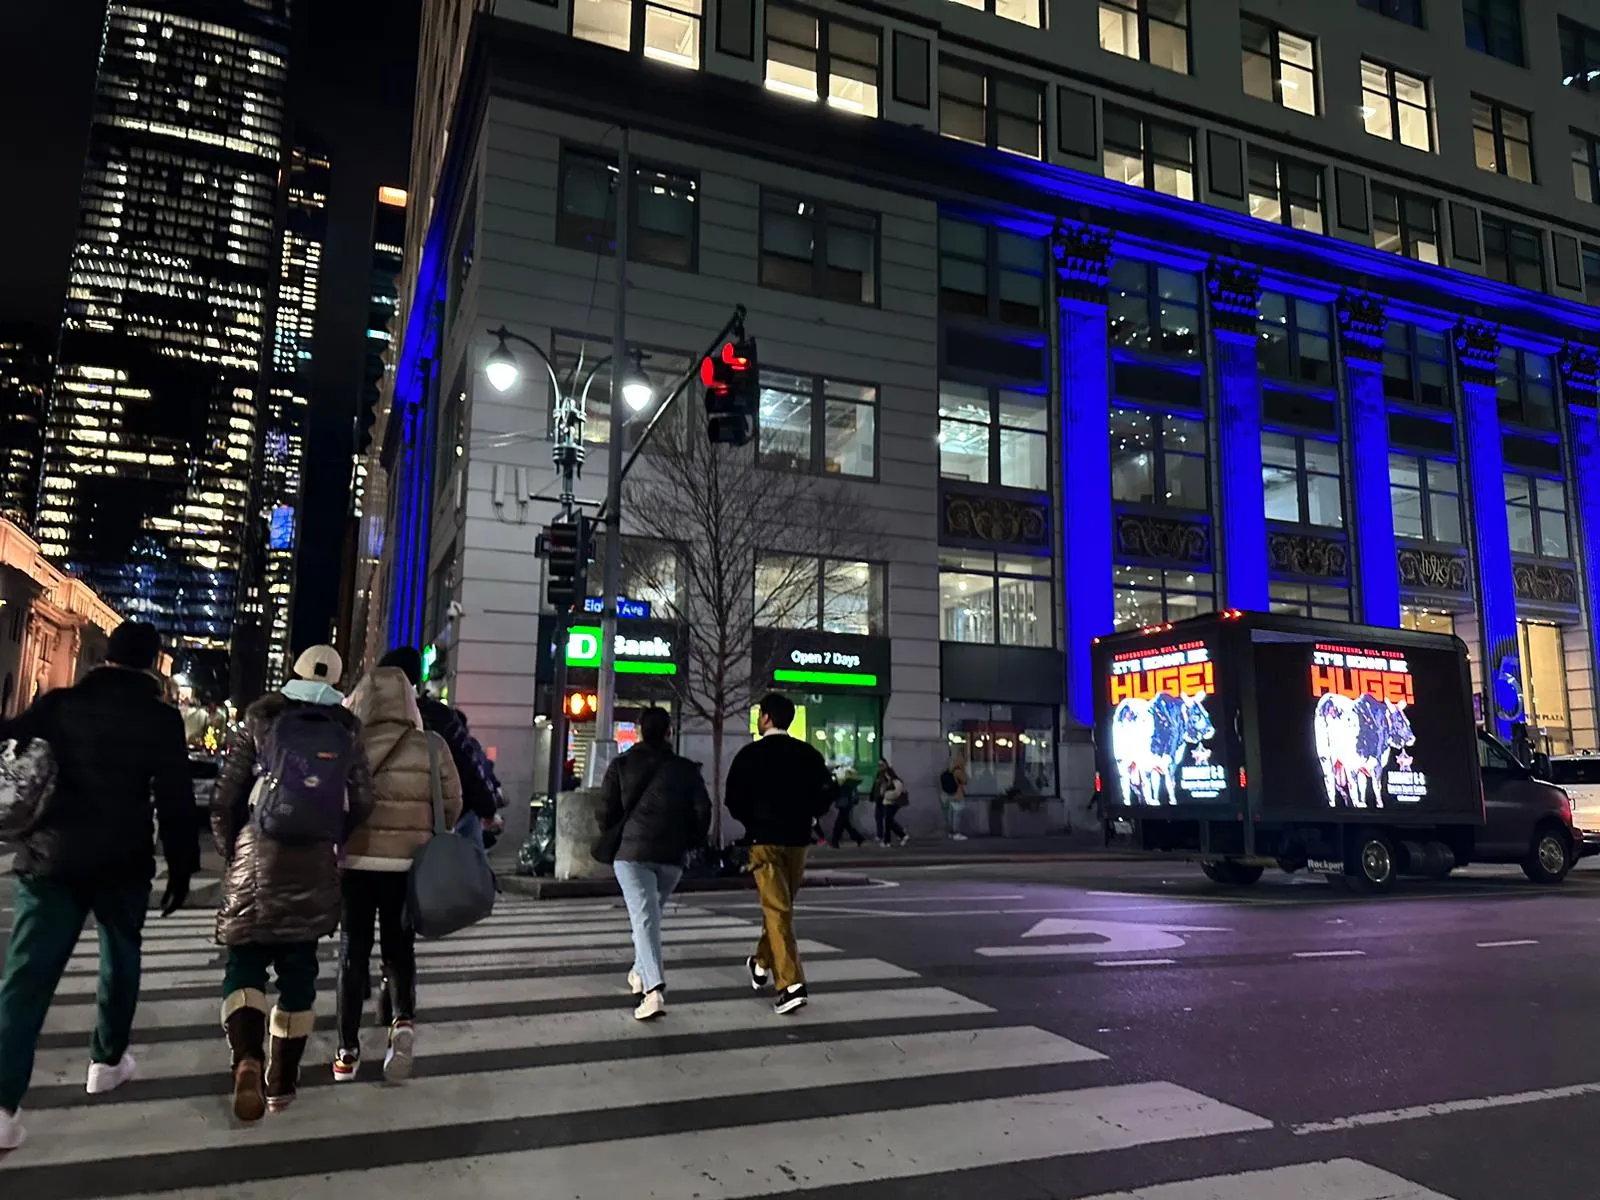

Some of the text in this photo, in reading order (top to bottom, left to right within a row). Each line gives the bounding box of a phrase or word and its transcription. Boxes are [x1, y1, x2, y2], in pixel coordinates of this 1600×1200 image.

[622, 604, 644, 616] Ave
[614, 635, 670, 656] Bank
[791, 650, 860, 668] Open 7 Days
[1110, 661, 1215, 705] HUGE!
[1310, 664, 1415, 705] HUGE!
